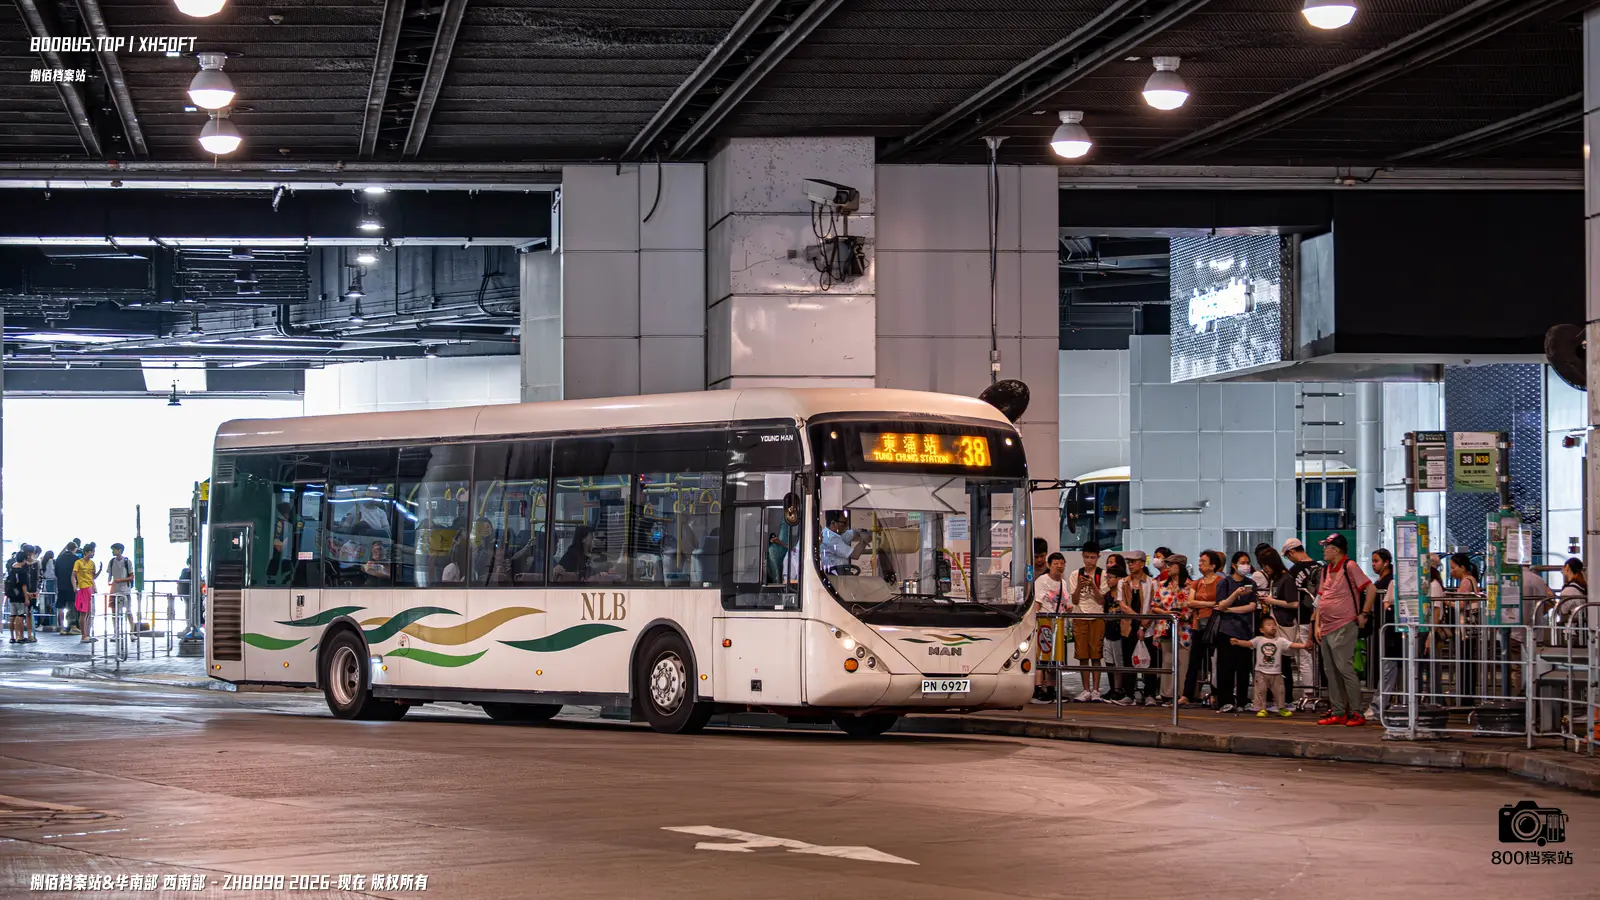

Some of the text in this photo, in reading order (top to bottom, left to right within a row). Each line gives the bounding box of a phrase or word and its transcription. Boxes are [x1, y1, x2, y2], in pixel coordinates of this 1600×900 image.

[882, 434, 936, 455] 東涌站
[873, 451, 949, 463] TUNG CHUNG STATION
[961, 437, 986, 466] 38
[1462, 455, 1489, 464] 38 N38
[580, 592, 627, 621] NLB
[928, 646, 962, 656] MAN
[923, 681, 968, 692] PN 6927
